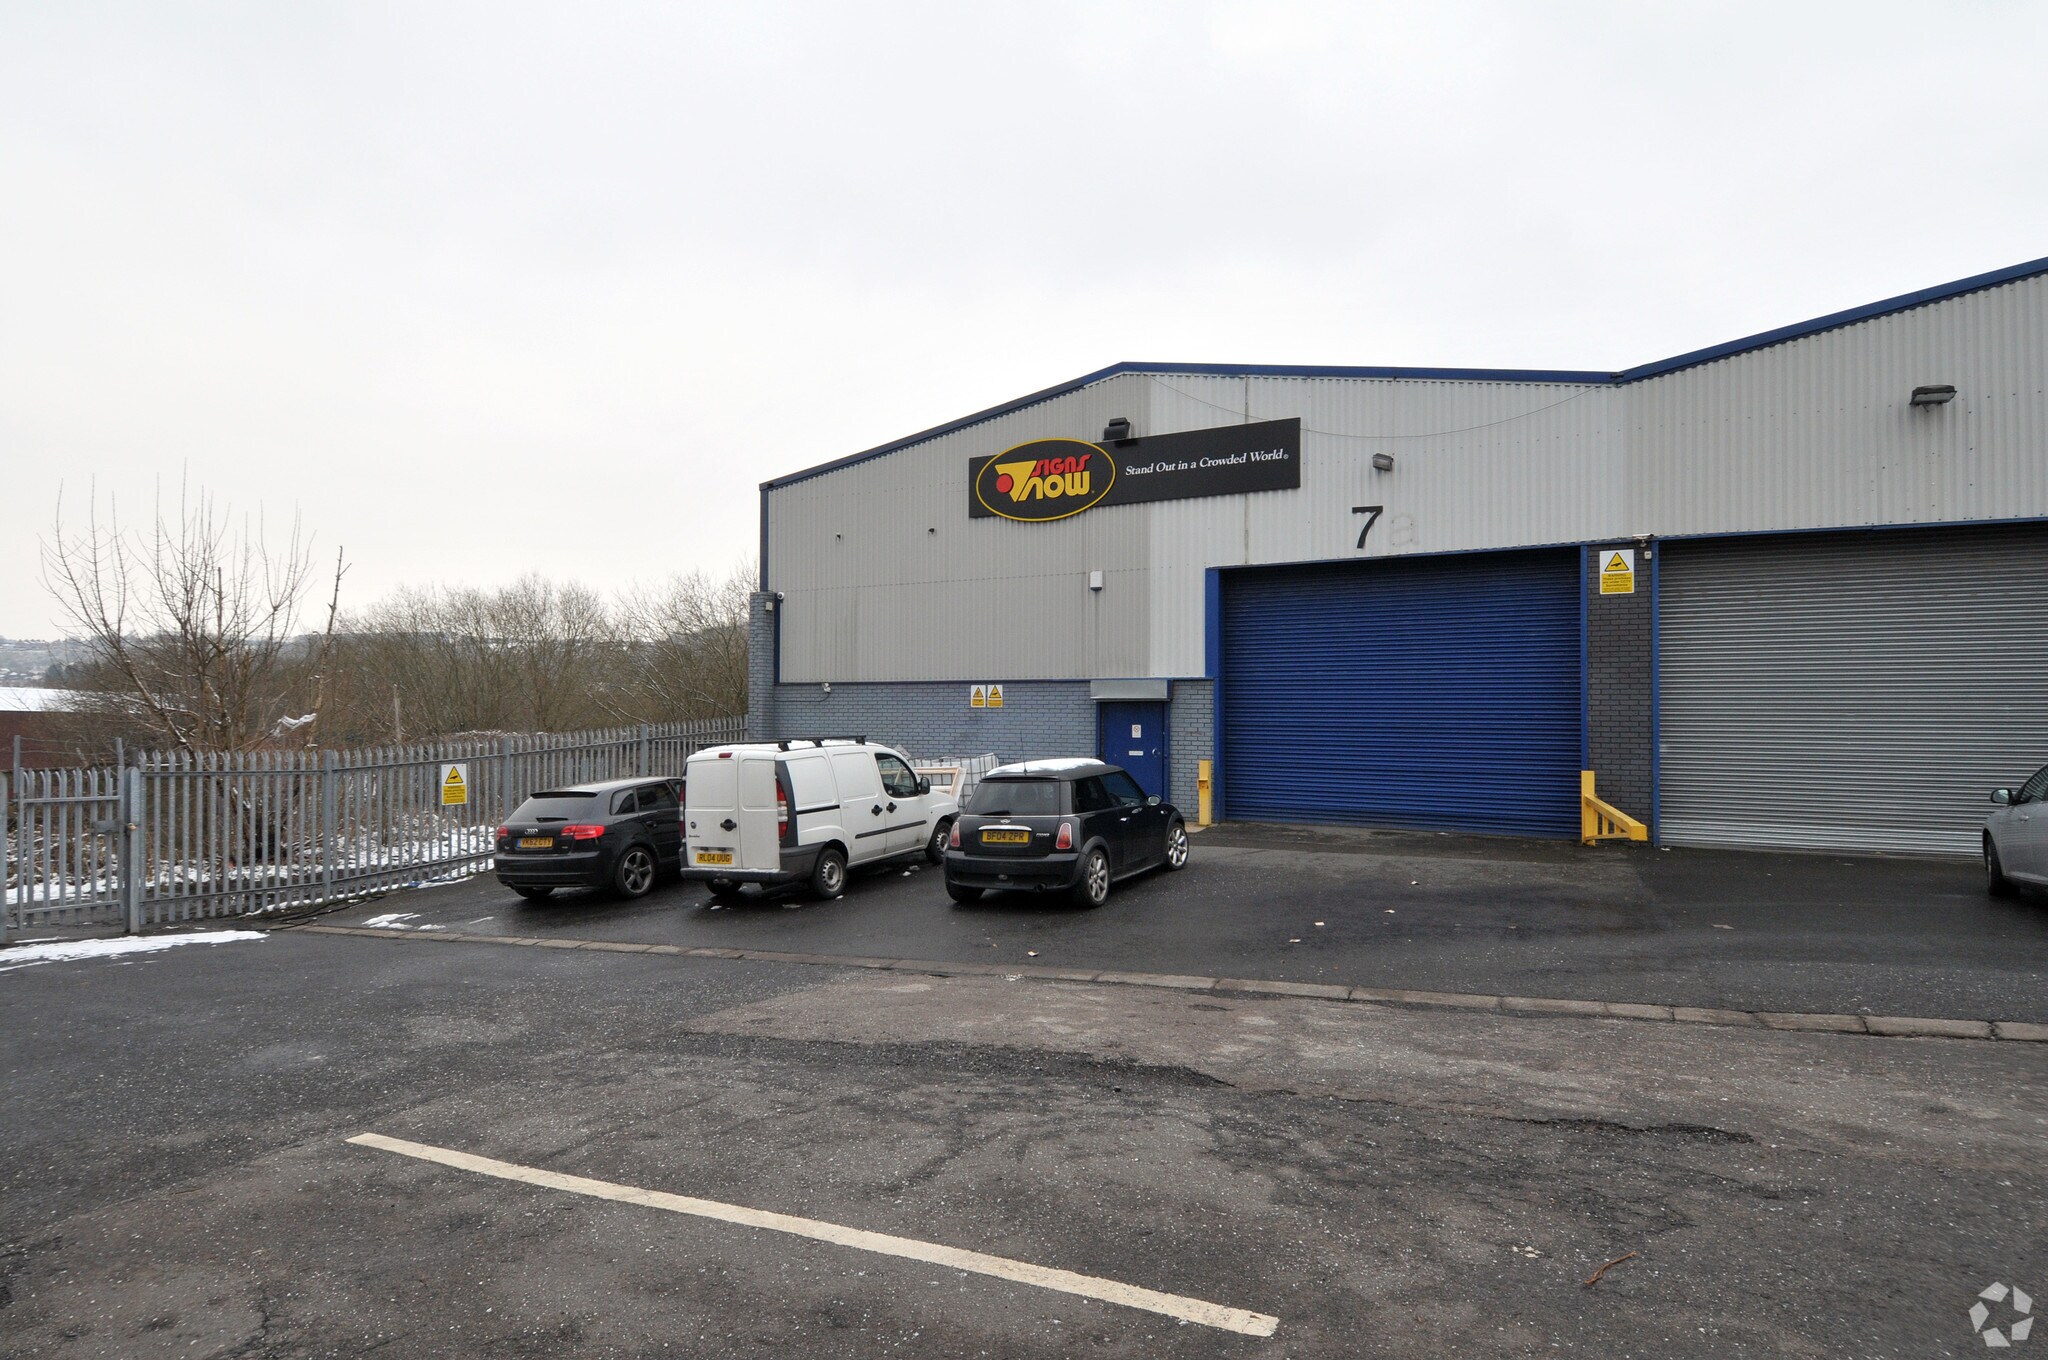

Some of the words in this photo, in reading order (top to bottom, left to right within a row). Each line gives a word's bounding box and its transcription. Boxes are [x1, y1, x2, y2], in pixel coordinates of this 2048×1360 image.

[1125, 463, 1154, 476] Stand
[1155, 462, 1176, 473] Out
[1177, 460, 1188, 470] in
[1190, 461, 1197, 469] a
[1199, 453, 1247, 468] Crowded
